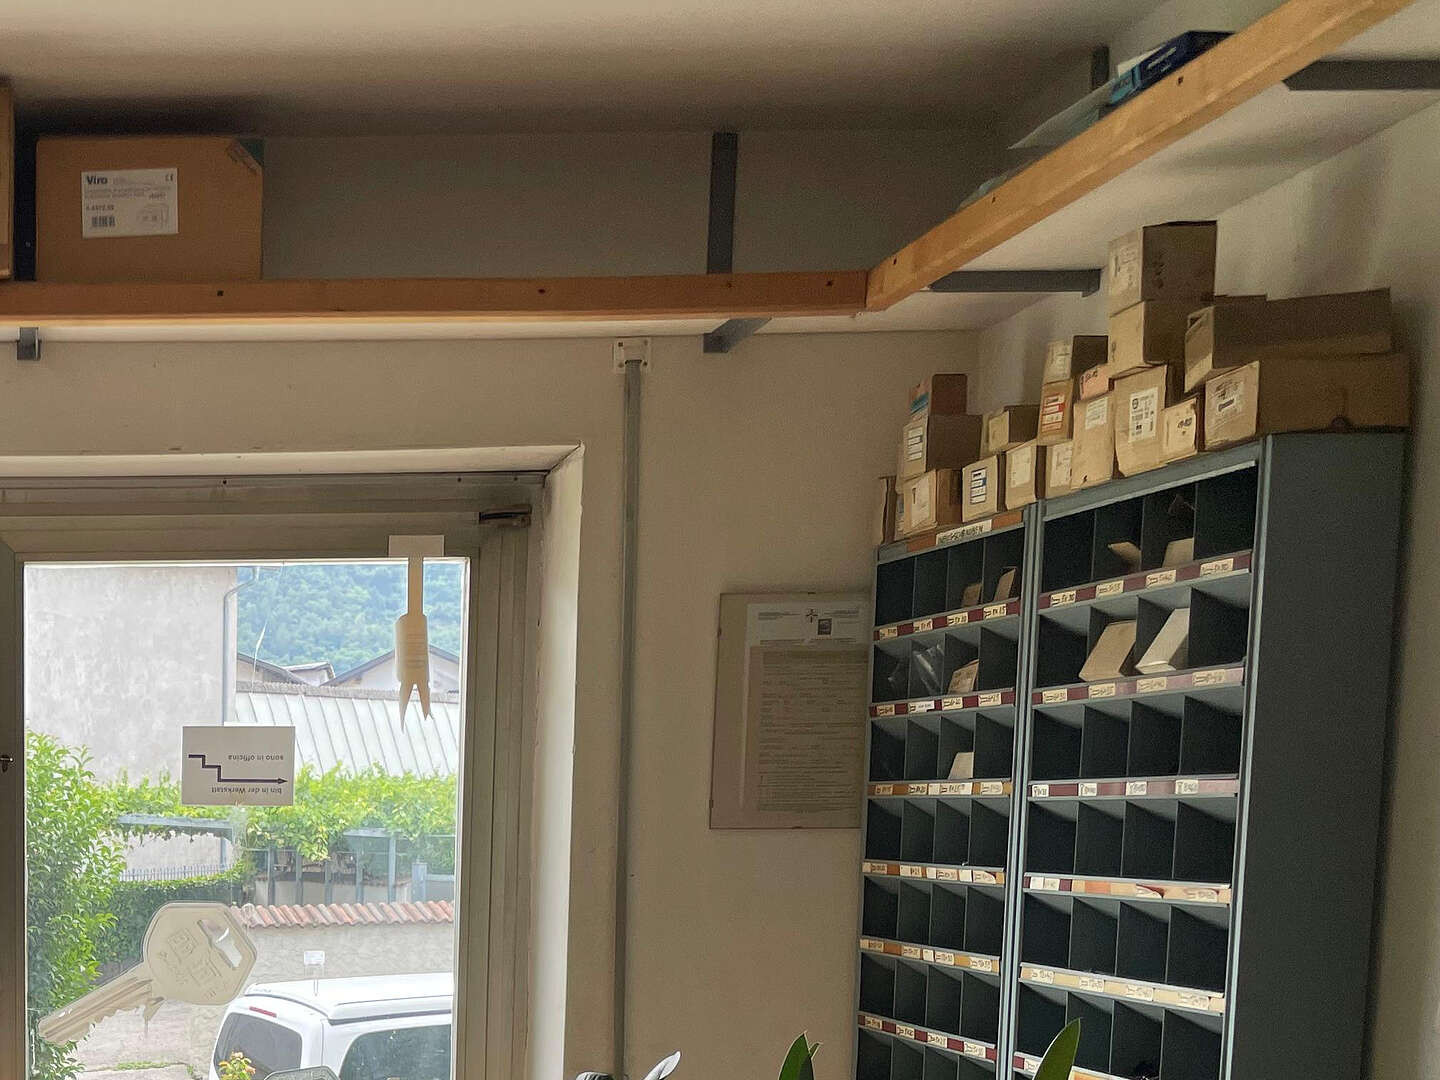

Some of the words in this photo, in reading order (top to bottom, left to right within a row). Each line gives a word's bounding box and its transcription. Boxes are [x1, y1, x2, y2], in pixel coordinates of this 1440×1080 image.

[86, 175, 108, 185] Viro
[228, 754, 255, 762] officina
[211, 786, 246, 795] Werkstatt
[248, 787, 260, 795] der
[271, 787, 282, 795] bin
